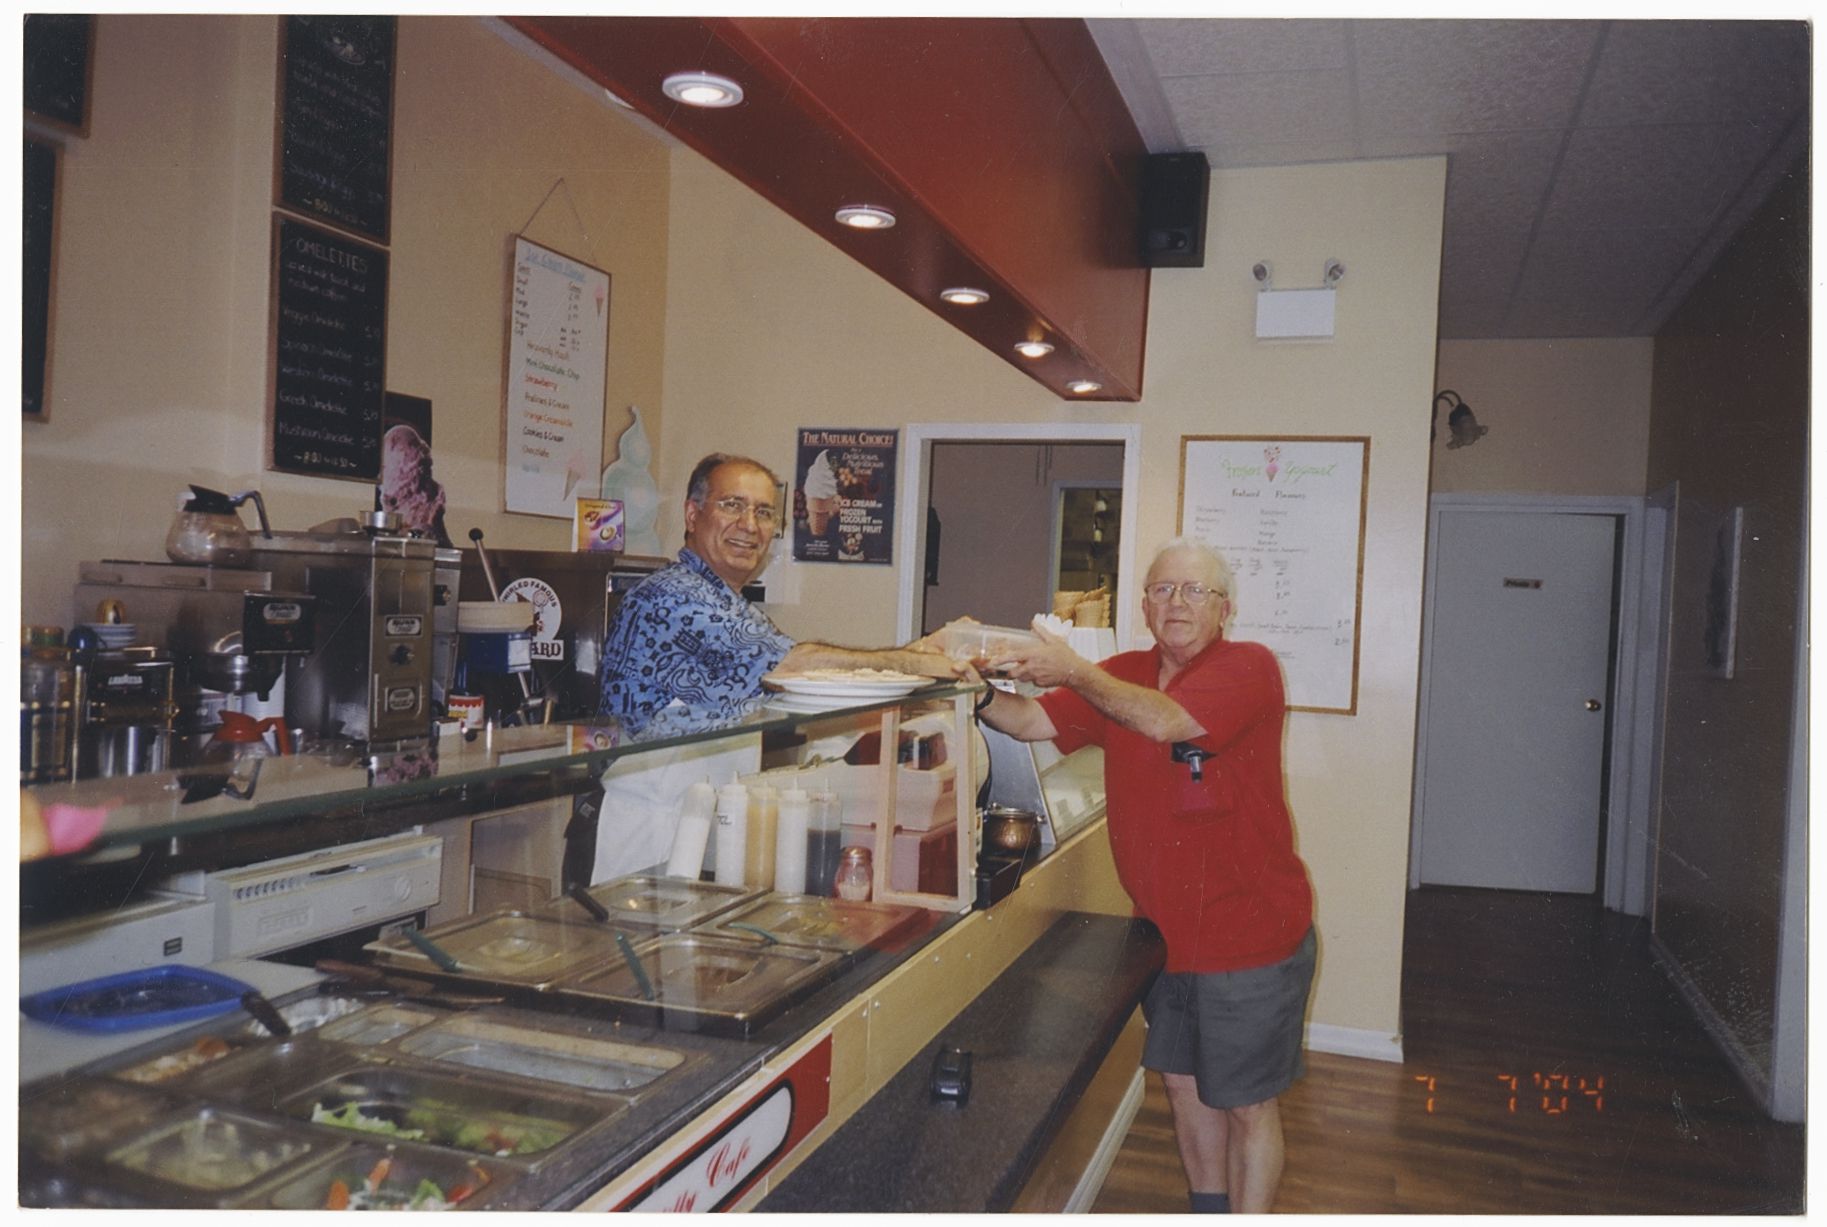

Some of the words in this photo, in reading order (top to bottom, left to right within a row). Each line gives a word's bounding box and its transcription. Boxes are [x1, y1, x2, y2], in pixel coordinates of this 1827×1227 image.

[296, 237, 368, 273] OMELETTES
[524, 371, 559, 392] Strawberry
[522, 425, 543, 440] Cookies
[840, 499, 851, 507] ICE
[852, 499, 877, 507] CREAM
[840, 508, 867, 516] FROZEN
[839, 525, 861, 533] FRESH
[862, 525, 883, 534] FRUIT
[530, 581, 558, 608] FAMOUS
